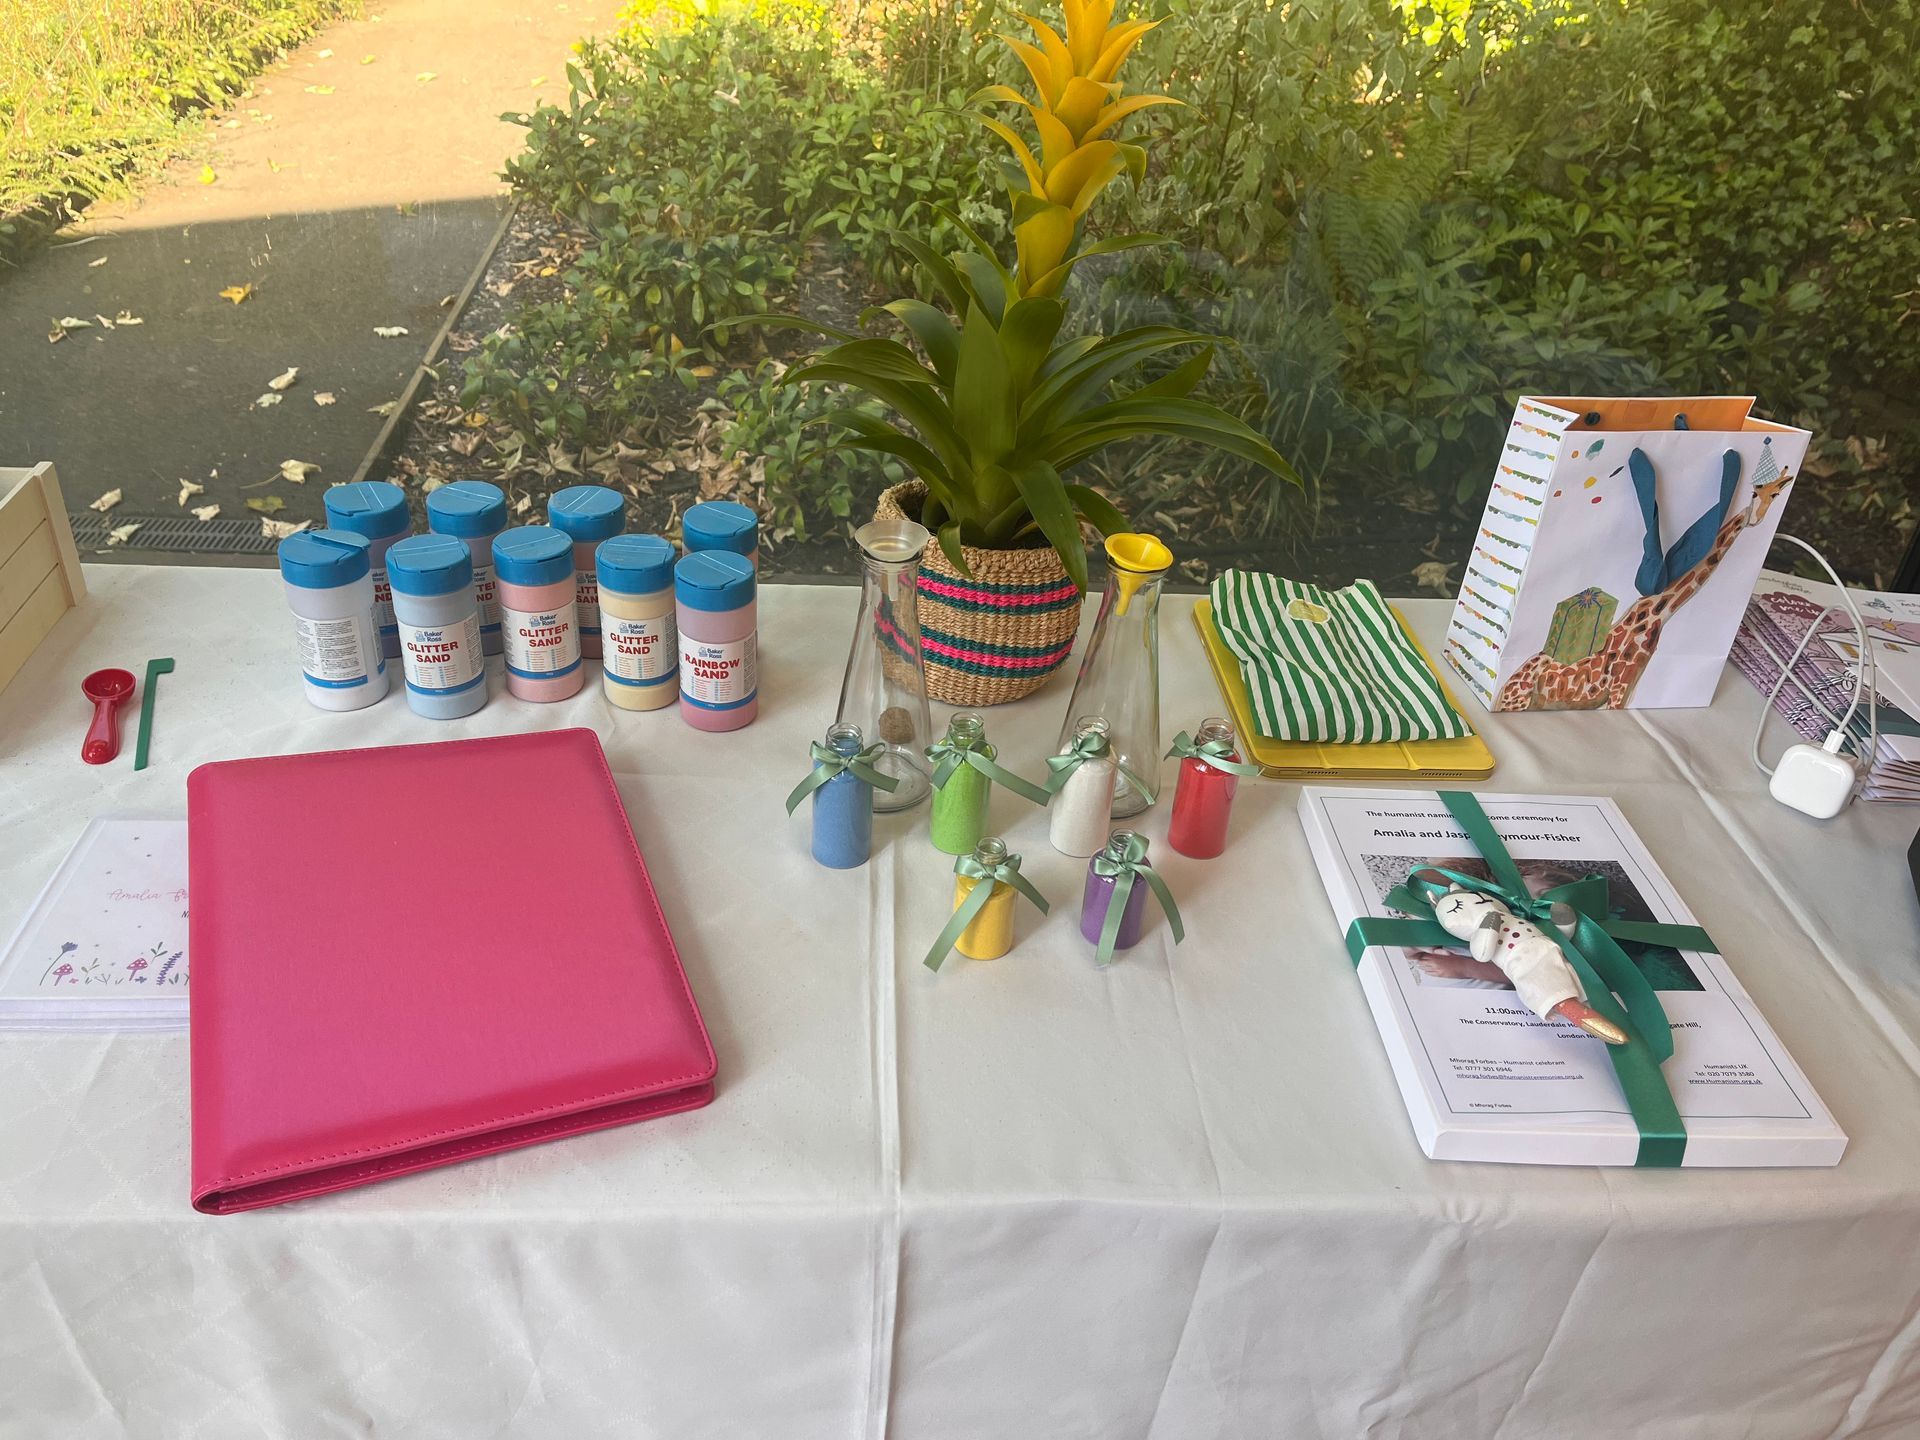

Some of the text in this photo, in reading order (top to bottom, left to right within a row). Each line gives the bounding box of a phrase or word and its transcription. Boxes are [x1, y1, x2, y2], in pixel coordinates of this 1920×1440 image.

[375, 592, 392, 603] ND
[476, 592, 493, 602] ND
[576, 594, 599, 604] SAN
[539, 613, 558, 621] Baker
[519, 622, 569, 637] GLITTER
[529, 636, 562, 647] SAND
[610, 632, 659, 645] GLITTER
[407, 641, 459, 653] GLITTER
[617, 644, 651, 655] SAND
[416, 654, 451, 663] SAND
[685, 653, 740, 670] RAINBOW
[694, 667, 729, 679] SAND
[1511, 815, 1554, 823] ceremony
[1373, 829, 1417, 838] Amalia
[1419, 830, 1443, 838] and
[1445, 830, 1471, 840] Jasp
[1485, 1007, 1528, 1016] 11:00am,
[1474, 1019, 1525, 1028] Conservatory,
[1449, 1057, 1475, 1065] Mhorag
